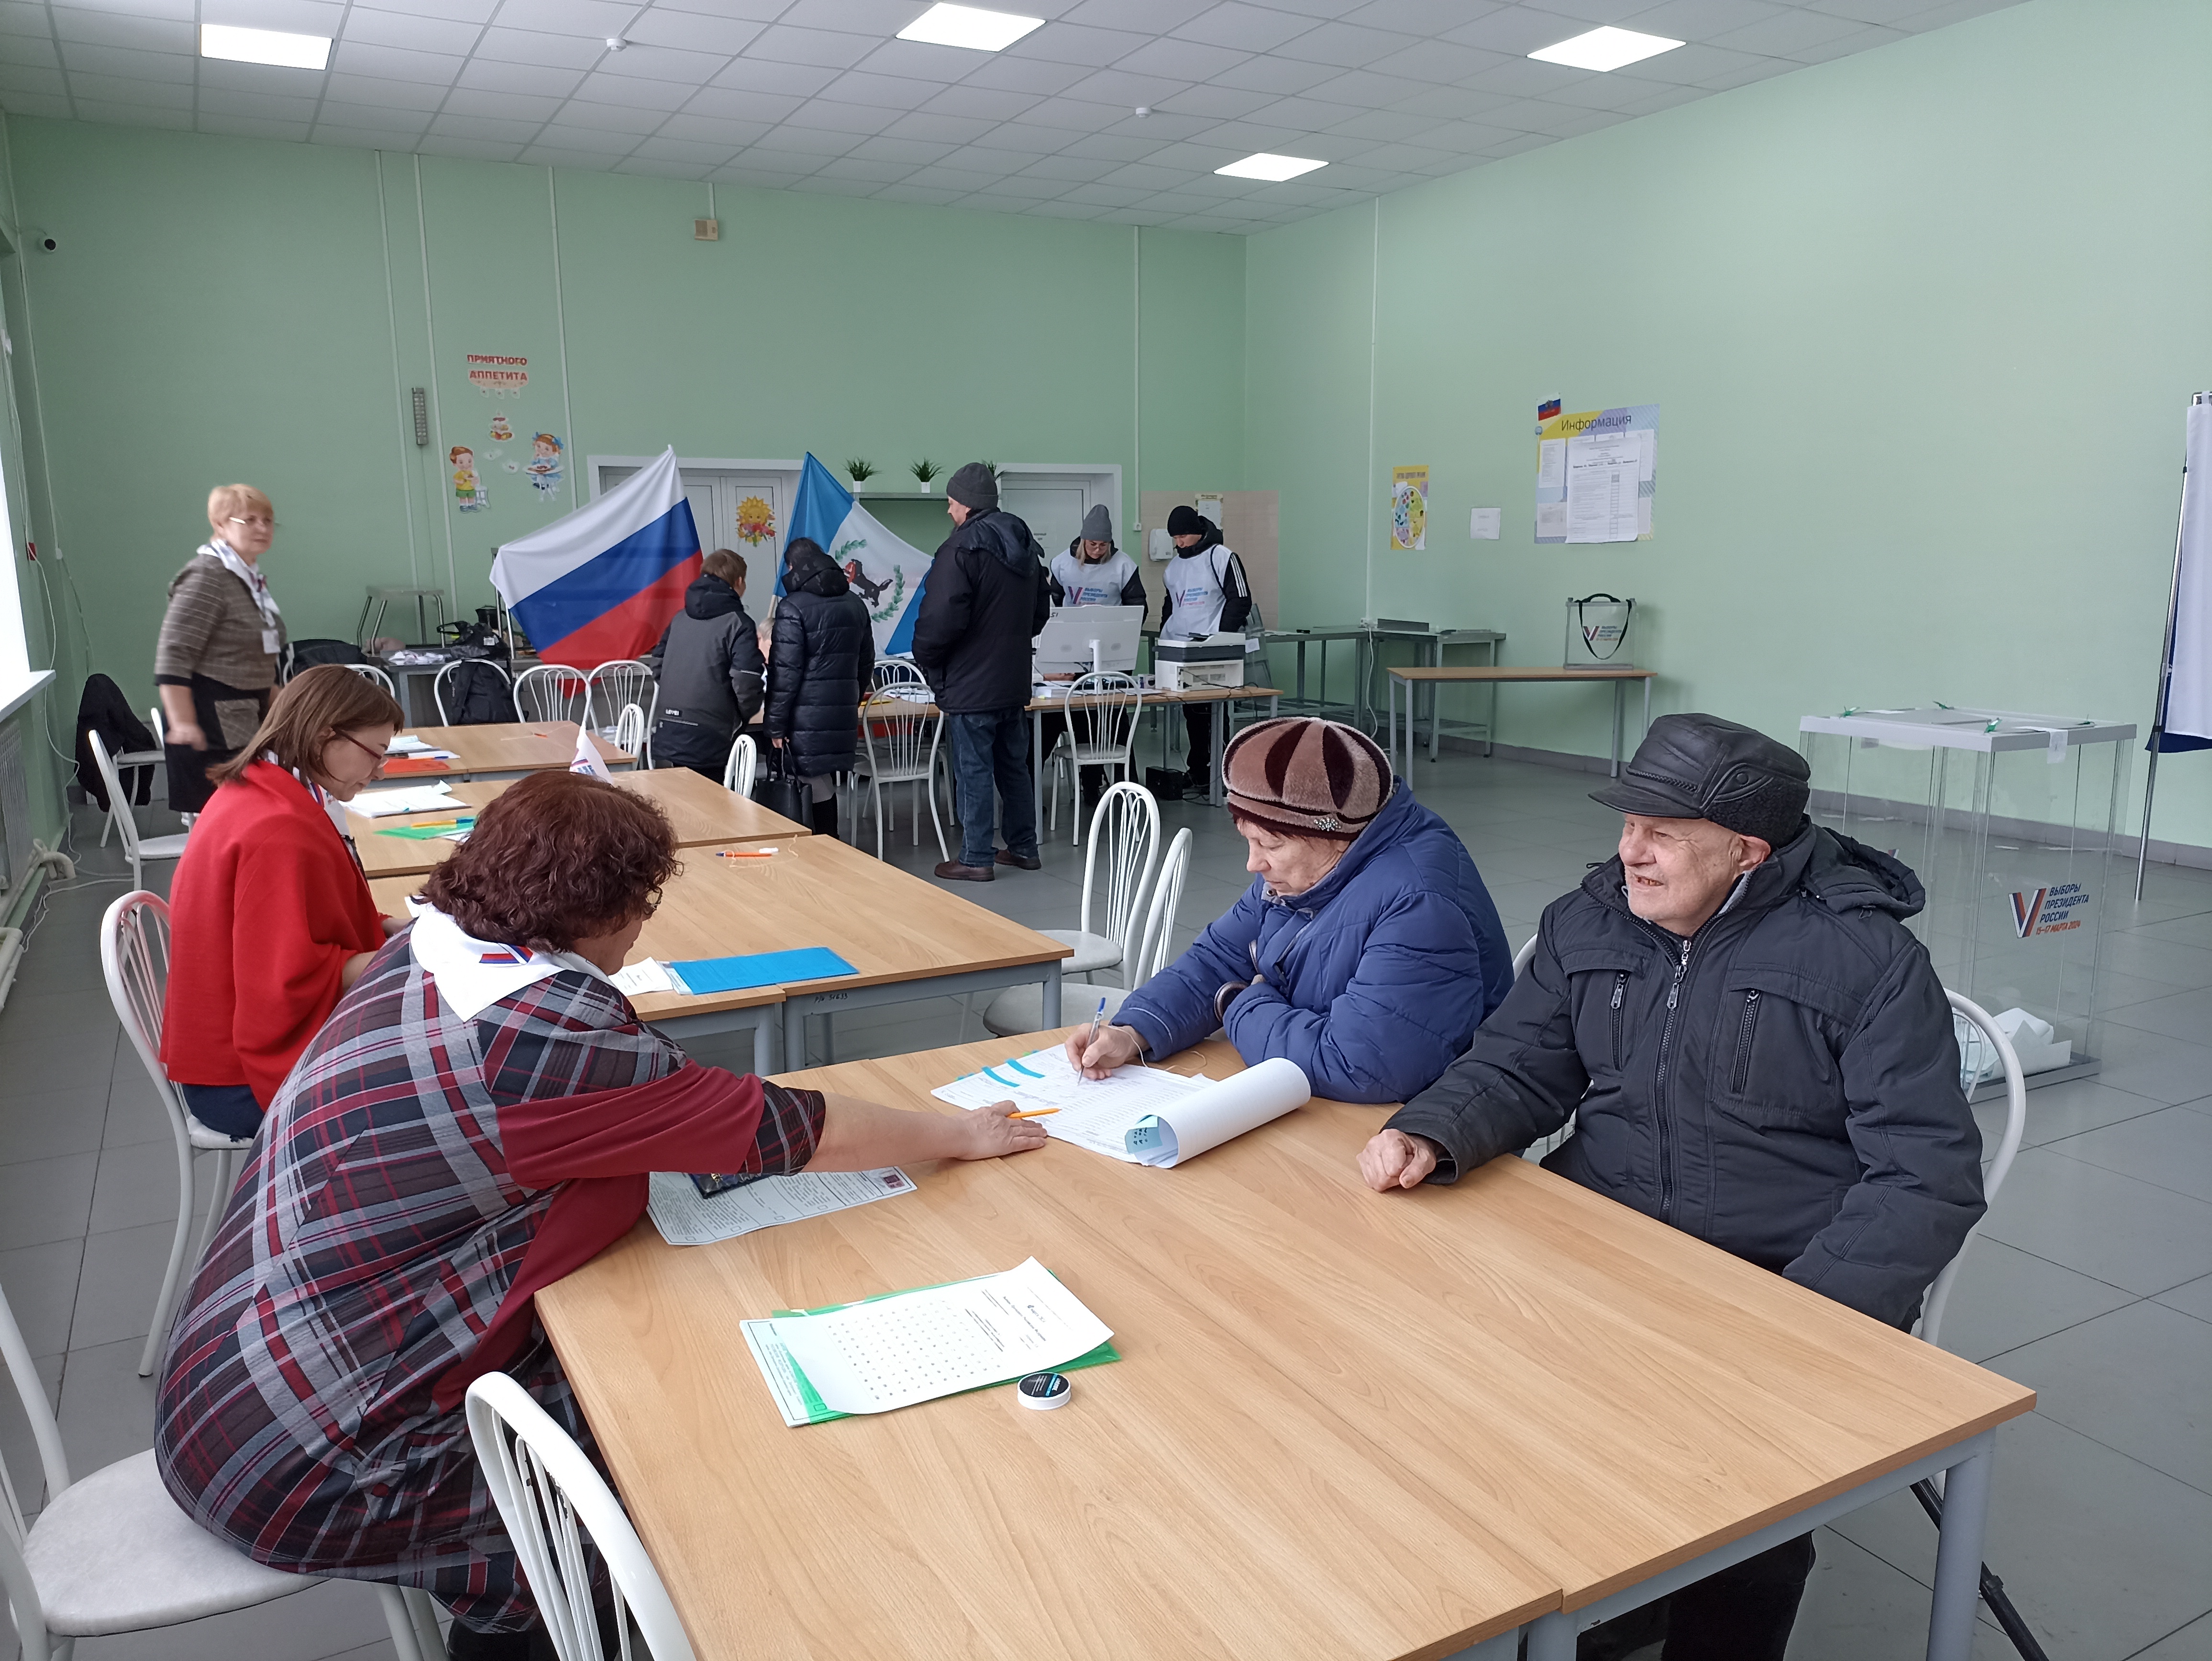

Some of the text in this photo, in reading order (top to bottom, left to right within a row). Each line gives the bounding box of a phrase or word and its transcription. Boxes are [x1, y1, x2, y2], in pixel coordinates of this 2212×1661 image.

[467, 354, 527, 366] ПРИЯТНОГО
[470, 370, 527, 381] АППЕТИТА
[1561, 415, 1631, 432] Информация
[2049, 883, 2081, 897] ВЫБОРЫ
[2045, 894, 2089, 909] ПРЕЗИДЕНТА
[2040, 910, 2069, 923] РОССИИ
[2050, 922, 2068, 932] МАРТА
